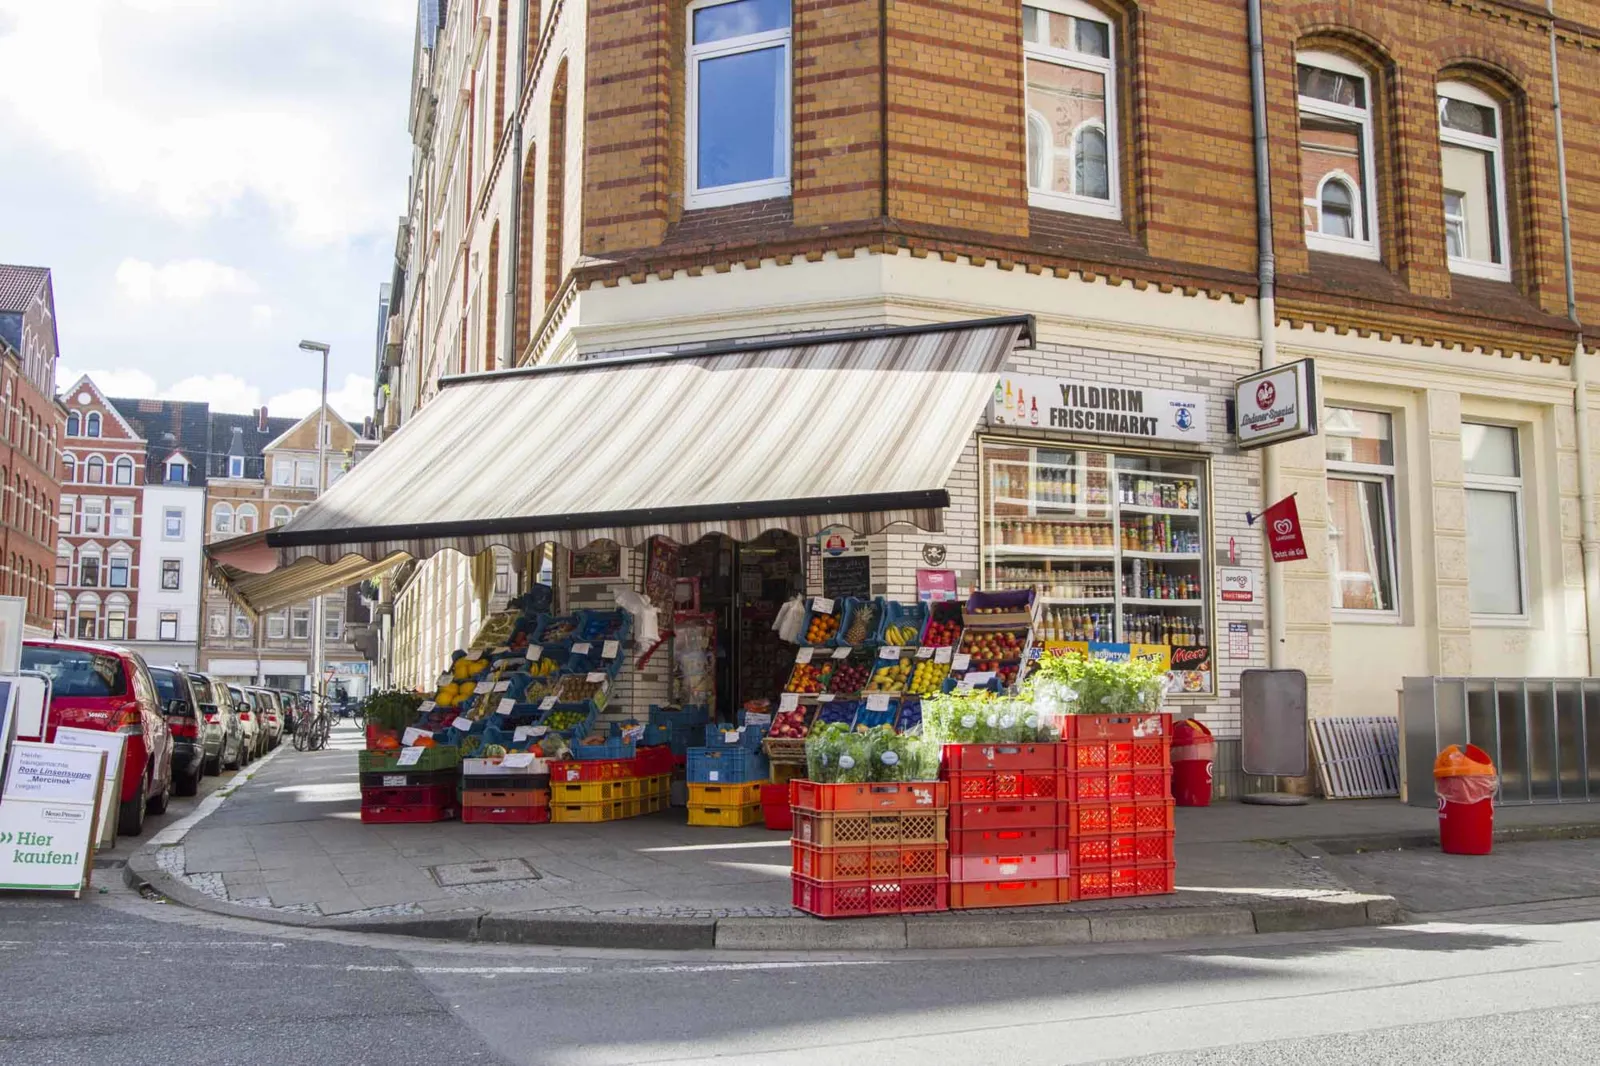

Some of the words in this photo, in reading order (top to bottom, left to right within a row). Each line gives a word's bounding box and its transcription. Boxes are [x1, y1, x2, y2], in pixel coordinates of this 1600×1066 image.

[1060, 384, 1143, 413] YILDIRIM
[1050, 407, 1159, 436] FRISCHMARKT
[1171, 647, 1208, 664] Mars
[18, 766, 38, 775] Rote
[39, 767, 93, 780] Linsensuppe
[16, 831, 54, 847] Hier
[12, 849, 79, 865] kaufen!
